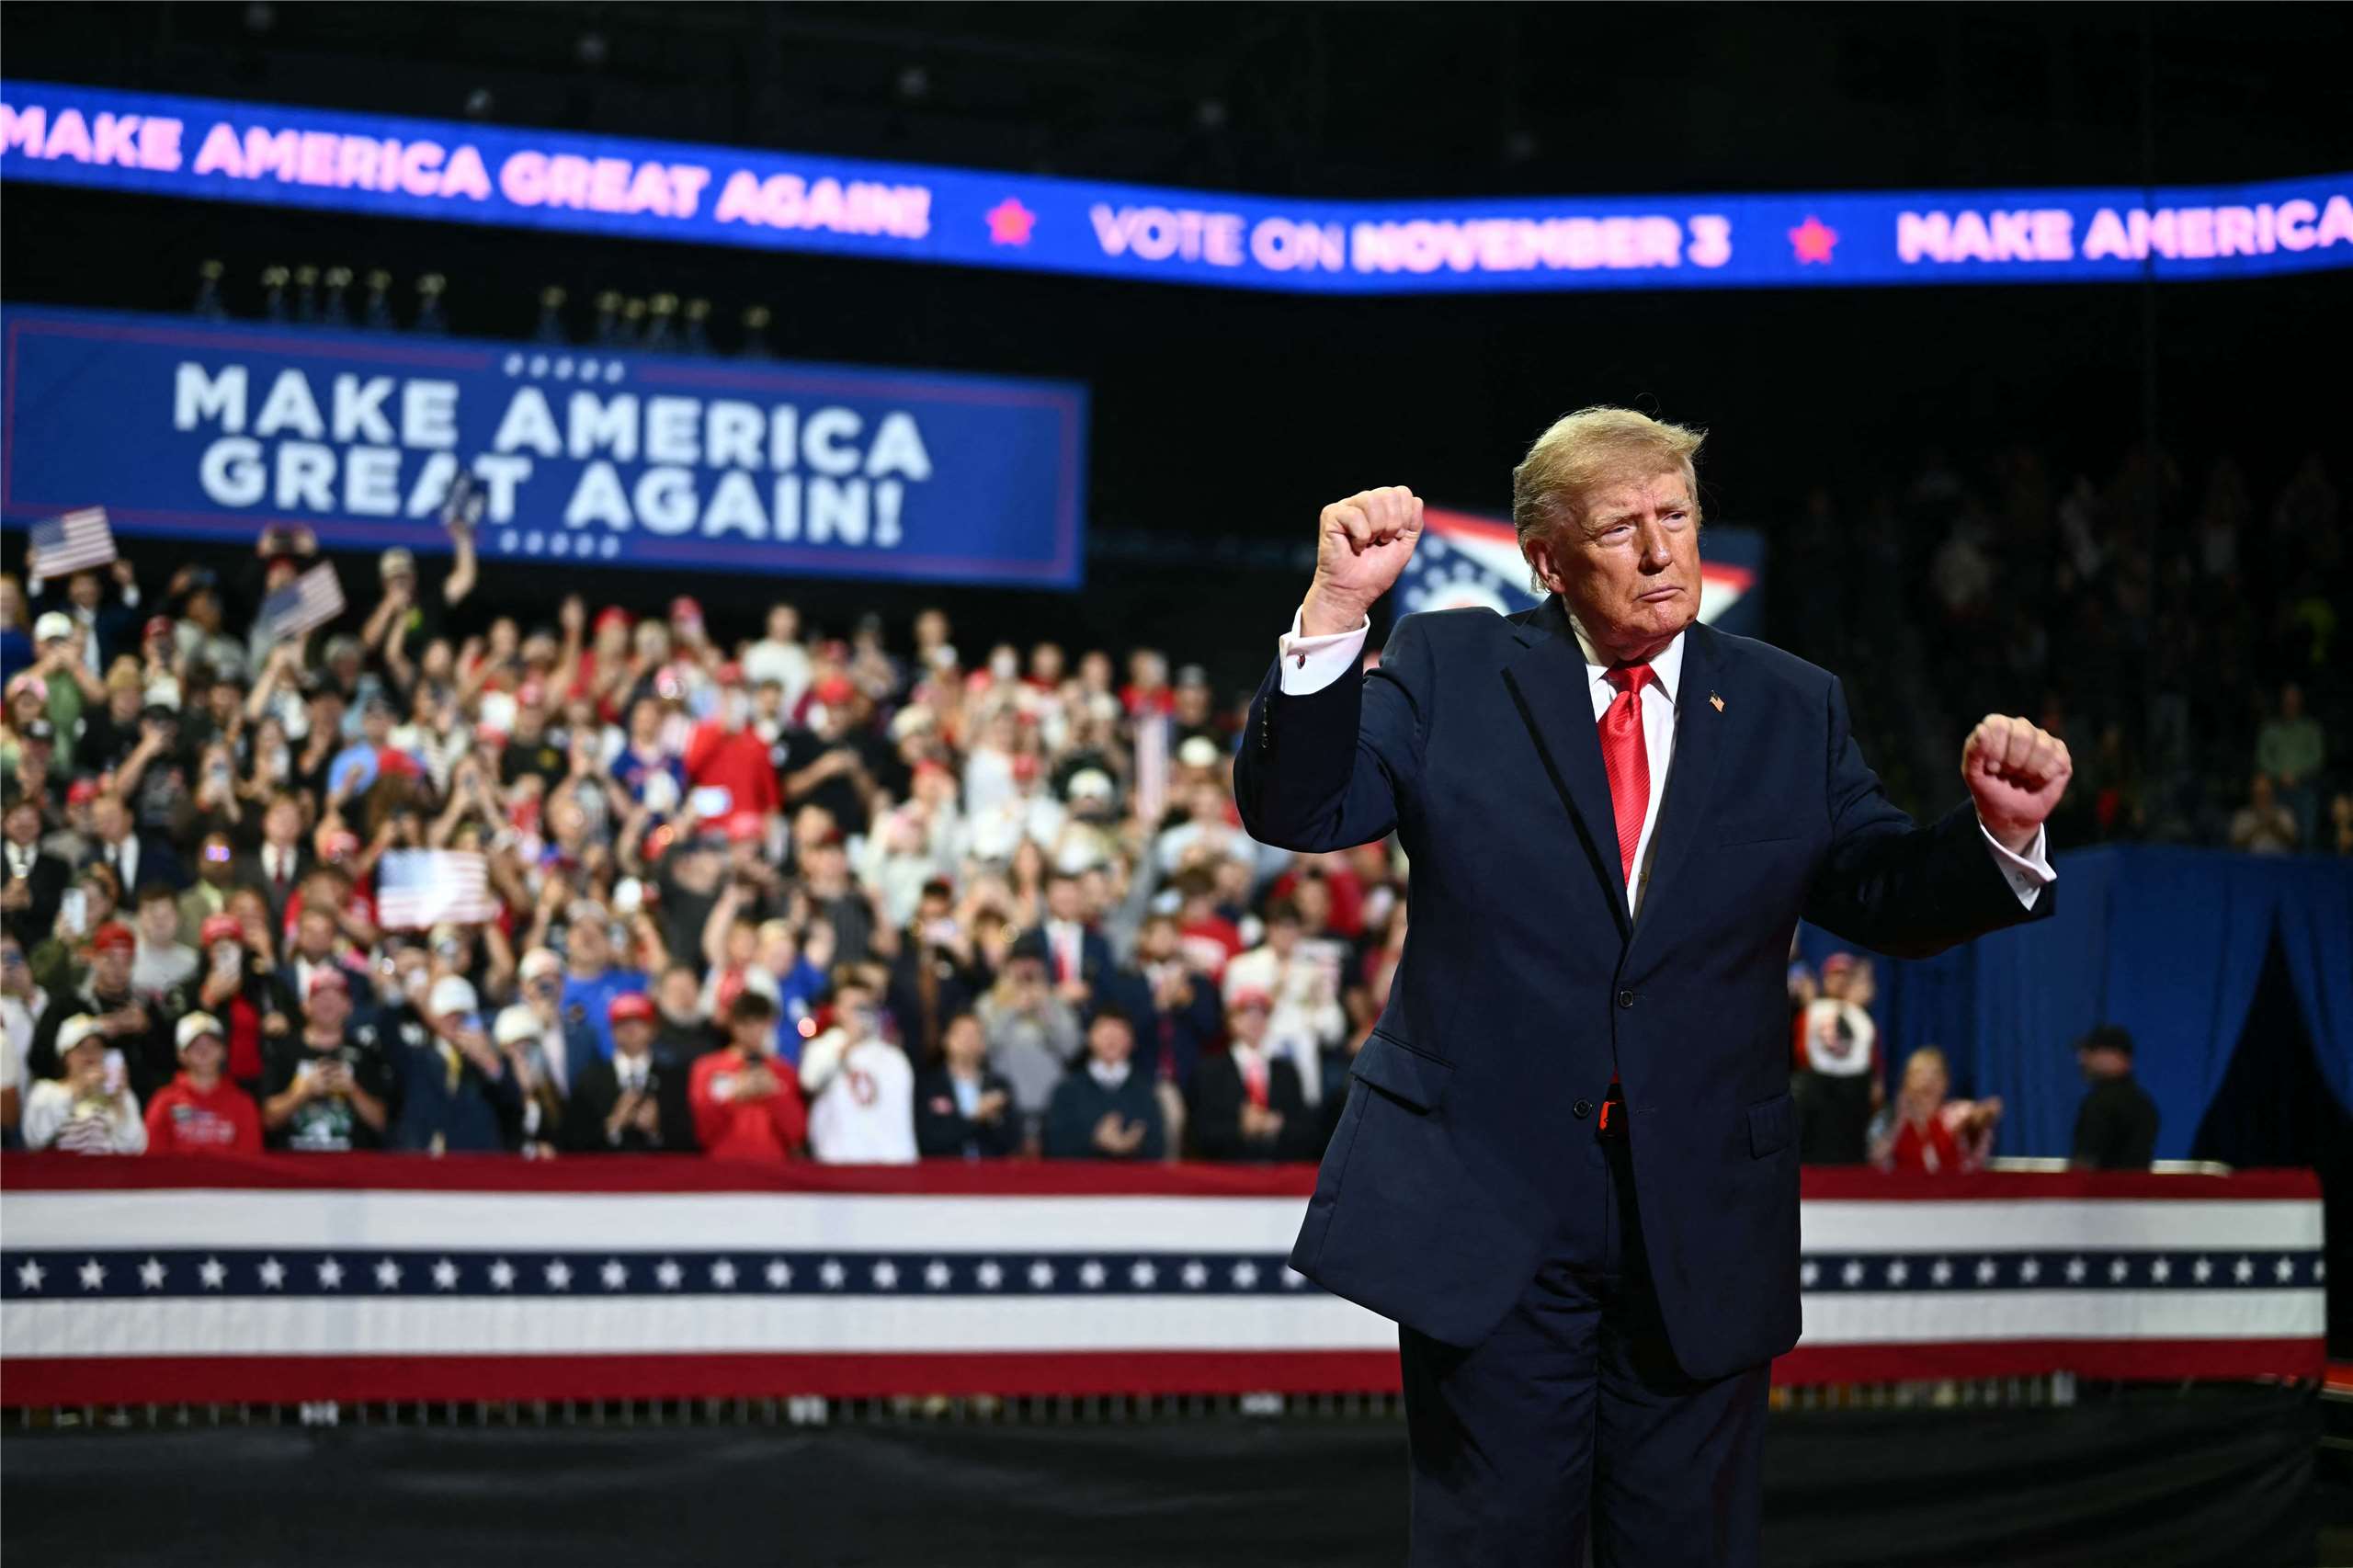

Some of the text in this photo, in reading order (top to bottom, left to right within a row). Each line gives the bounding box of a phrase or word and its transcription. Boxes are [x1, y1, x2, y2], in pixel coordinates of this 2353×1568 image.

[0, 103, 931, 239] MAKE AMERICA GREAT AGAIN!
[1089, 204, 1732, 273] VOTE ON NOVEMBER 3
[1897, 196, 2353, 263] MAKE AMERICA
[175, 361, 932, 482] MAKE AMERICA
[563, 461, 904, 548] AGAIN!
